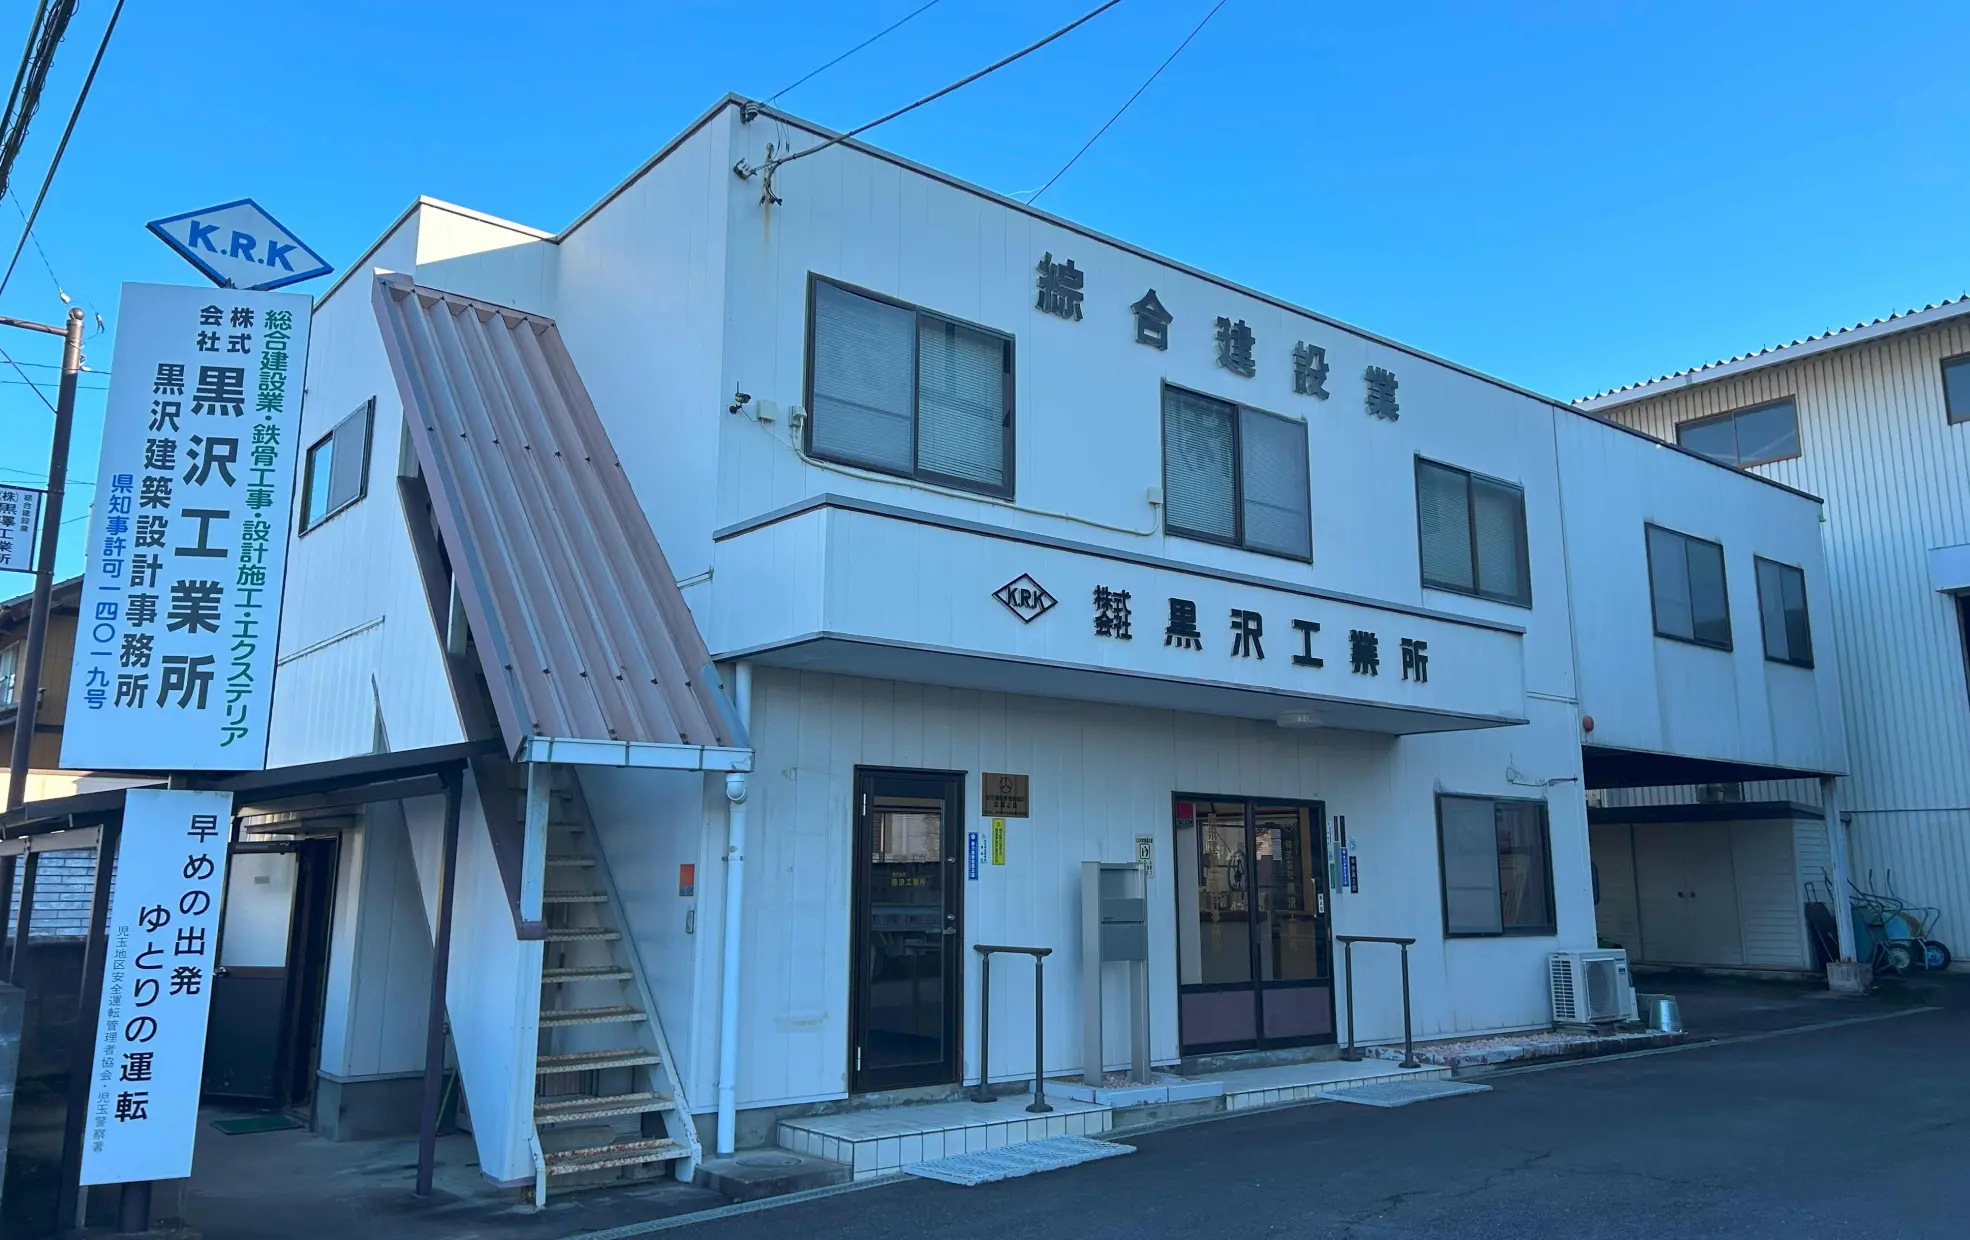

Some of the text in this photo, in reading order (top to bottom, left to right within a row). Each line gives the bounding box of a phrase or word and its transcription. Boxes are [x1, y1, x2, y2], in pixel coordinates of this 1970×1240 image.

[188, 219, 298, 273] K.R.K
[1035, 252, 1400, 421] 綜合建設業
[114, 363, 185, 710] 黒沢建築設計事務所
[156, 304, 254, 711] 株式会社 黒沢工業所
[1092, 584, 1429, 683] 株式会社 黒沢工業所
[169, 814, 219, 996] 早めの出発
[114, 904, 171, 1123] ゆとりの運転
